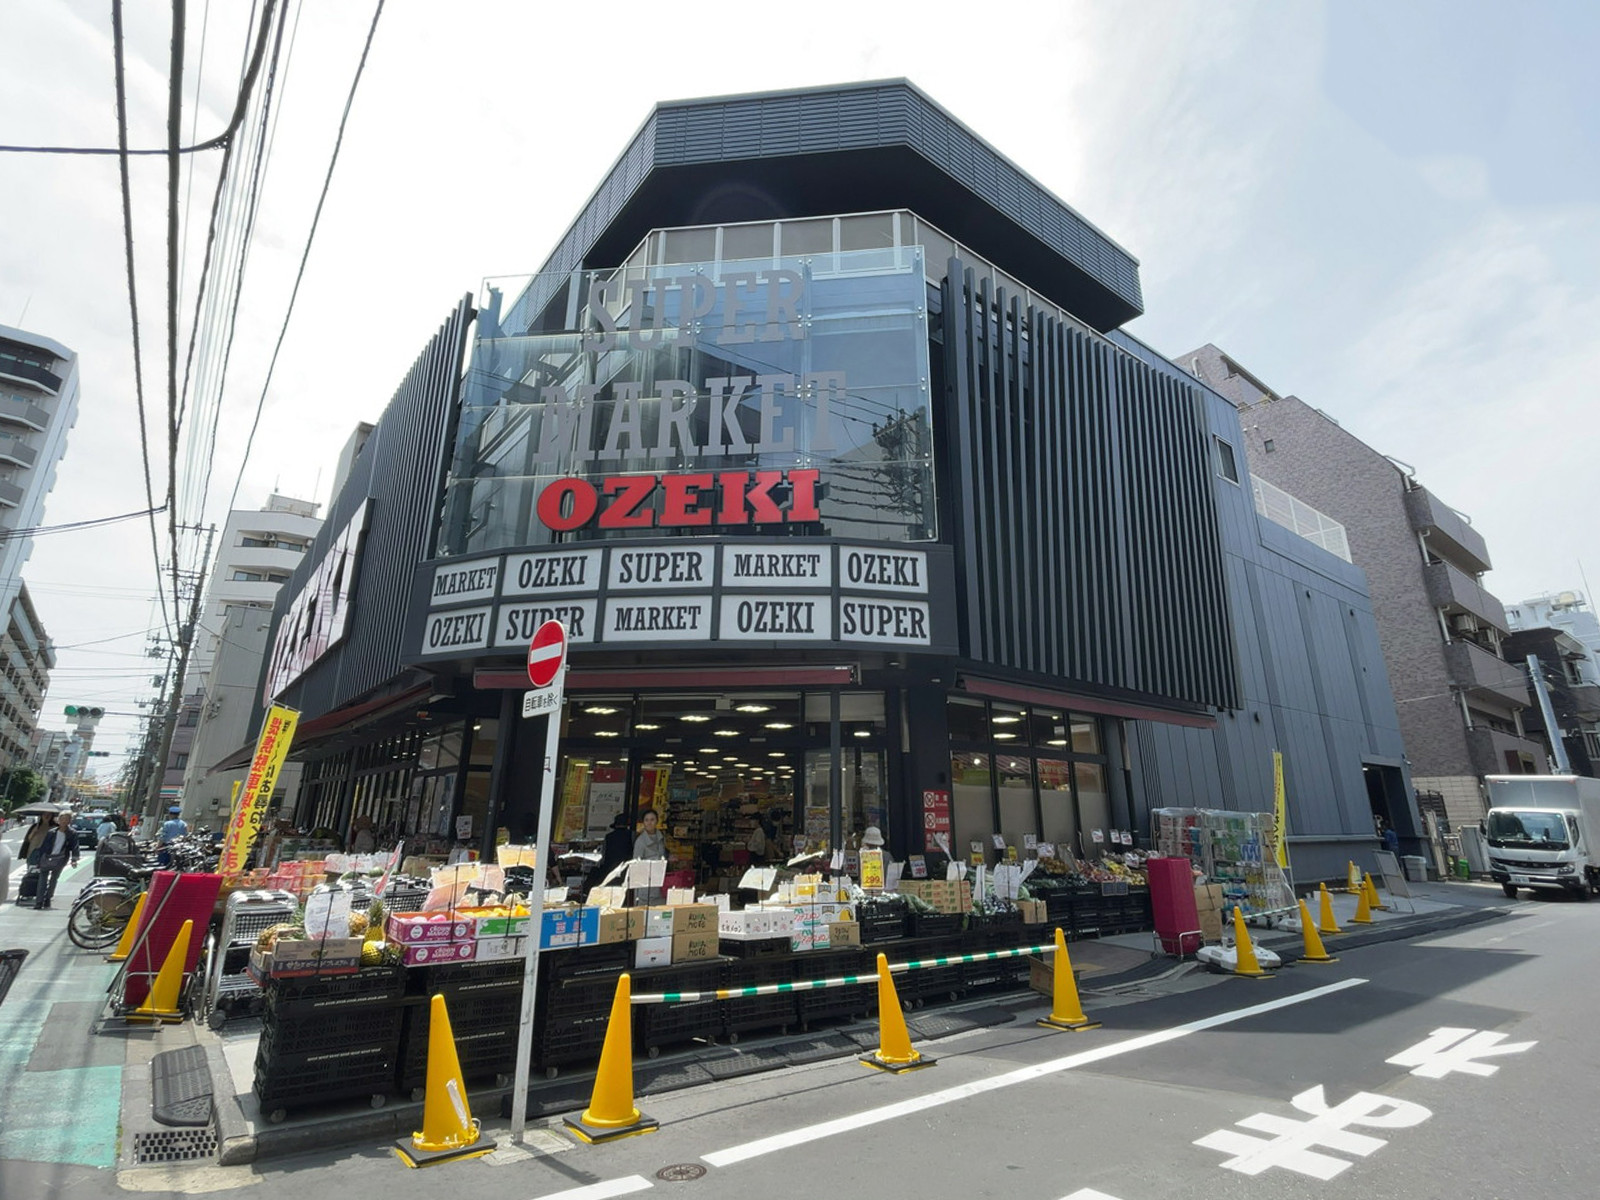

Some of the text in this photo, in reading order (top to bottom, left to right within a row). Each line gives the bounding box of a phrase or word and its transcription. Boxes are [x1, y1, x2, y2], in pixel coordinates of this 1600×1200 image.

[584, 268, 807, 353] SUPER
[534, 370, 847, 463] MARKET
[536, 468, 821, 532] OZEKI
[433, 564, 498, 597] MARKET
[517, 554, 588, 590] OZEKI
[619, 551, 703, 583] SUPER
[734, 553, 820, 578] MARKET
[847, 553, 920, 587] OZEKI
[429, 612, 484, 648] OZEKI
[615, 605, 701, 631] MARKET
[737, 601, 815, 633] OZEKI
[843, 603, 927, 638] SUPER
